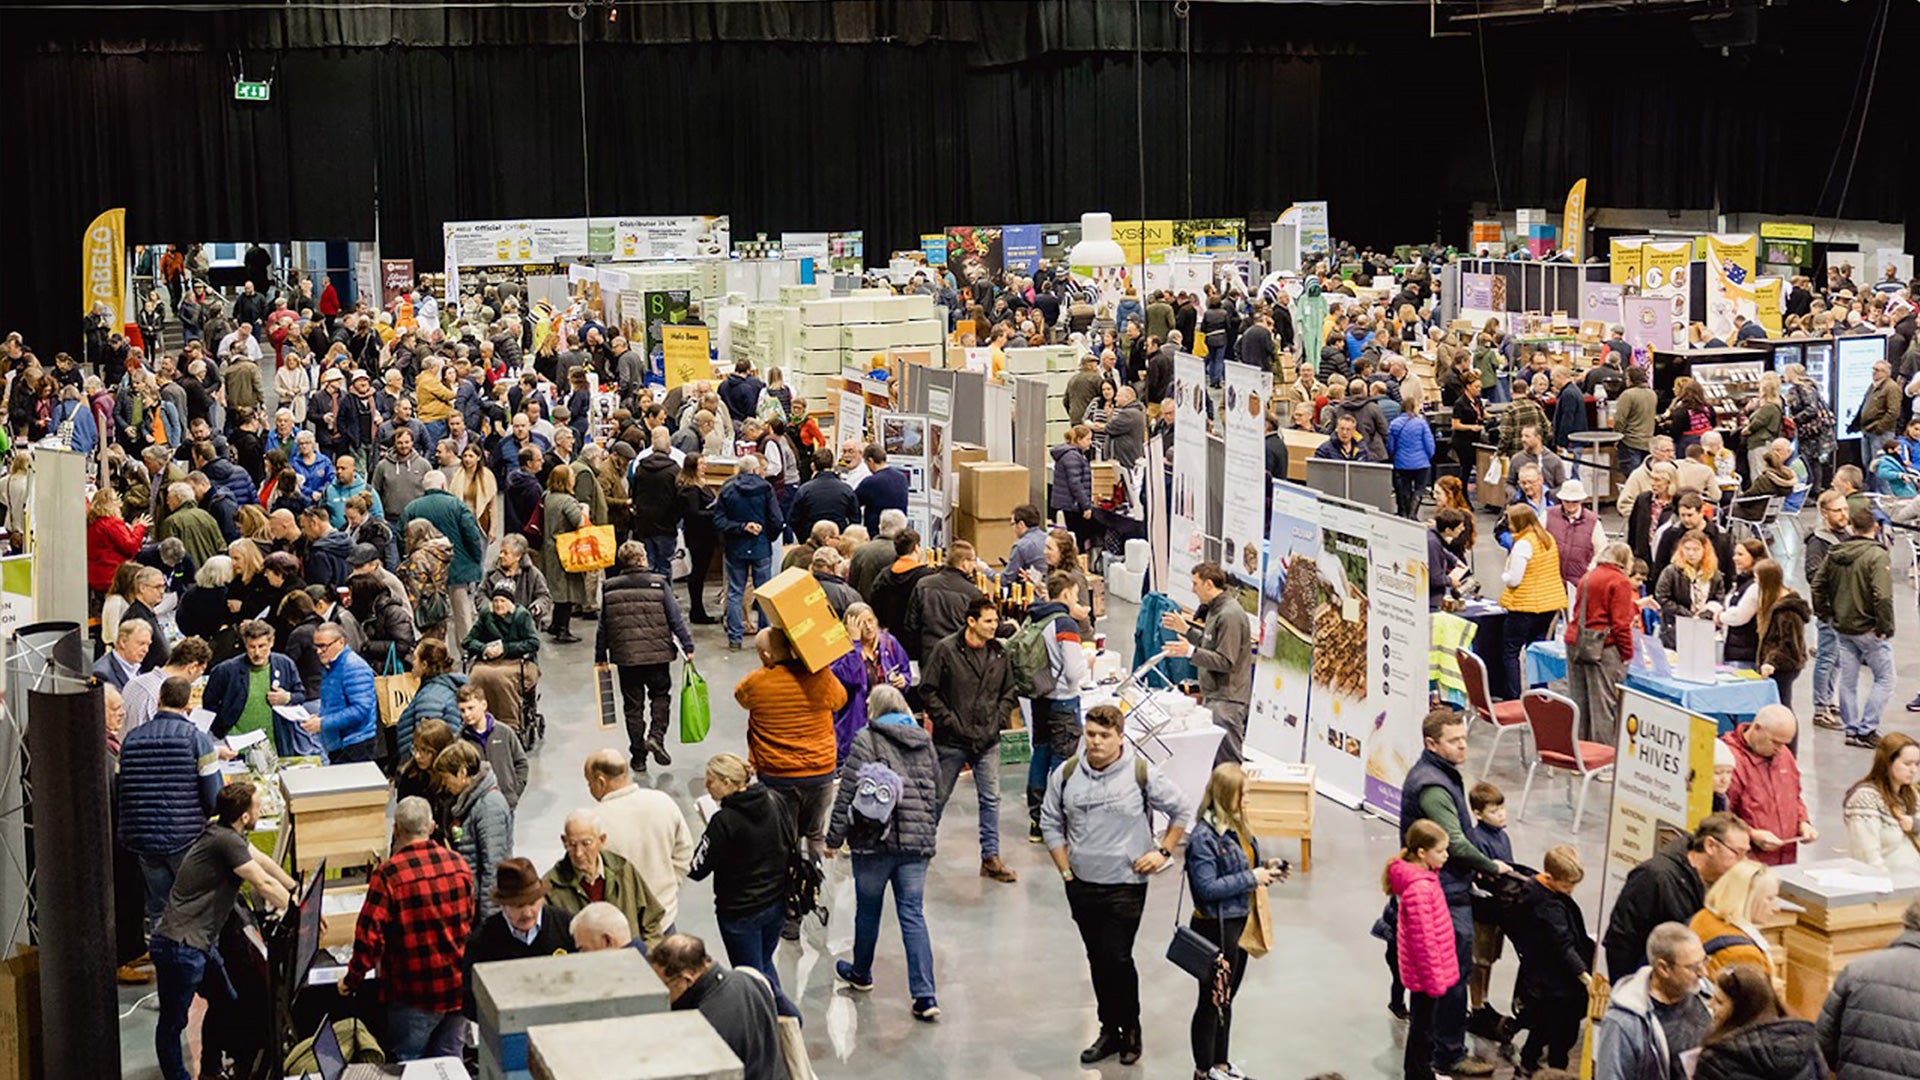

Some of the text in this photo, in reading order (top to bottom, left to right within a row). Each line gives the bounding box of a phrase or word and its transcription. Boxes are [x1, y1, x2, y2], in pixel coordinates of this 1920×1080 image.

[474, 224, 502, 232] Official
[619, 220, 657, 228] Distributor
[667, 219, 677, 227] UK
[92, 226, 113, 298] ABELO
[1626, 713, 1685, 752] QUALITY
[1639, 744, 1680, 775] HIVES
[1634, 771, 1671, 791] made from
[1648, 790, 1662, 805] Red
[1621, 805, 1647, 824] NATIONAL
